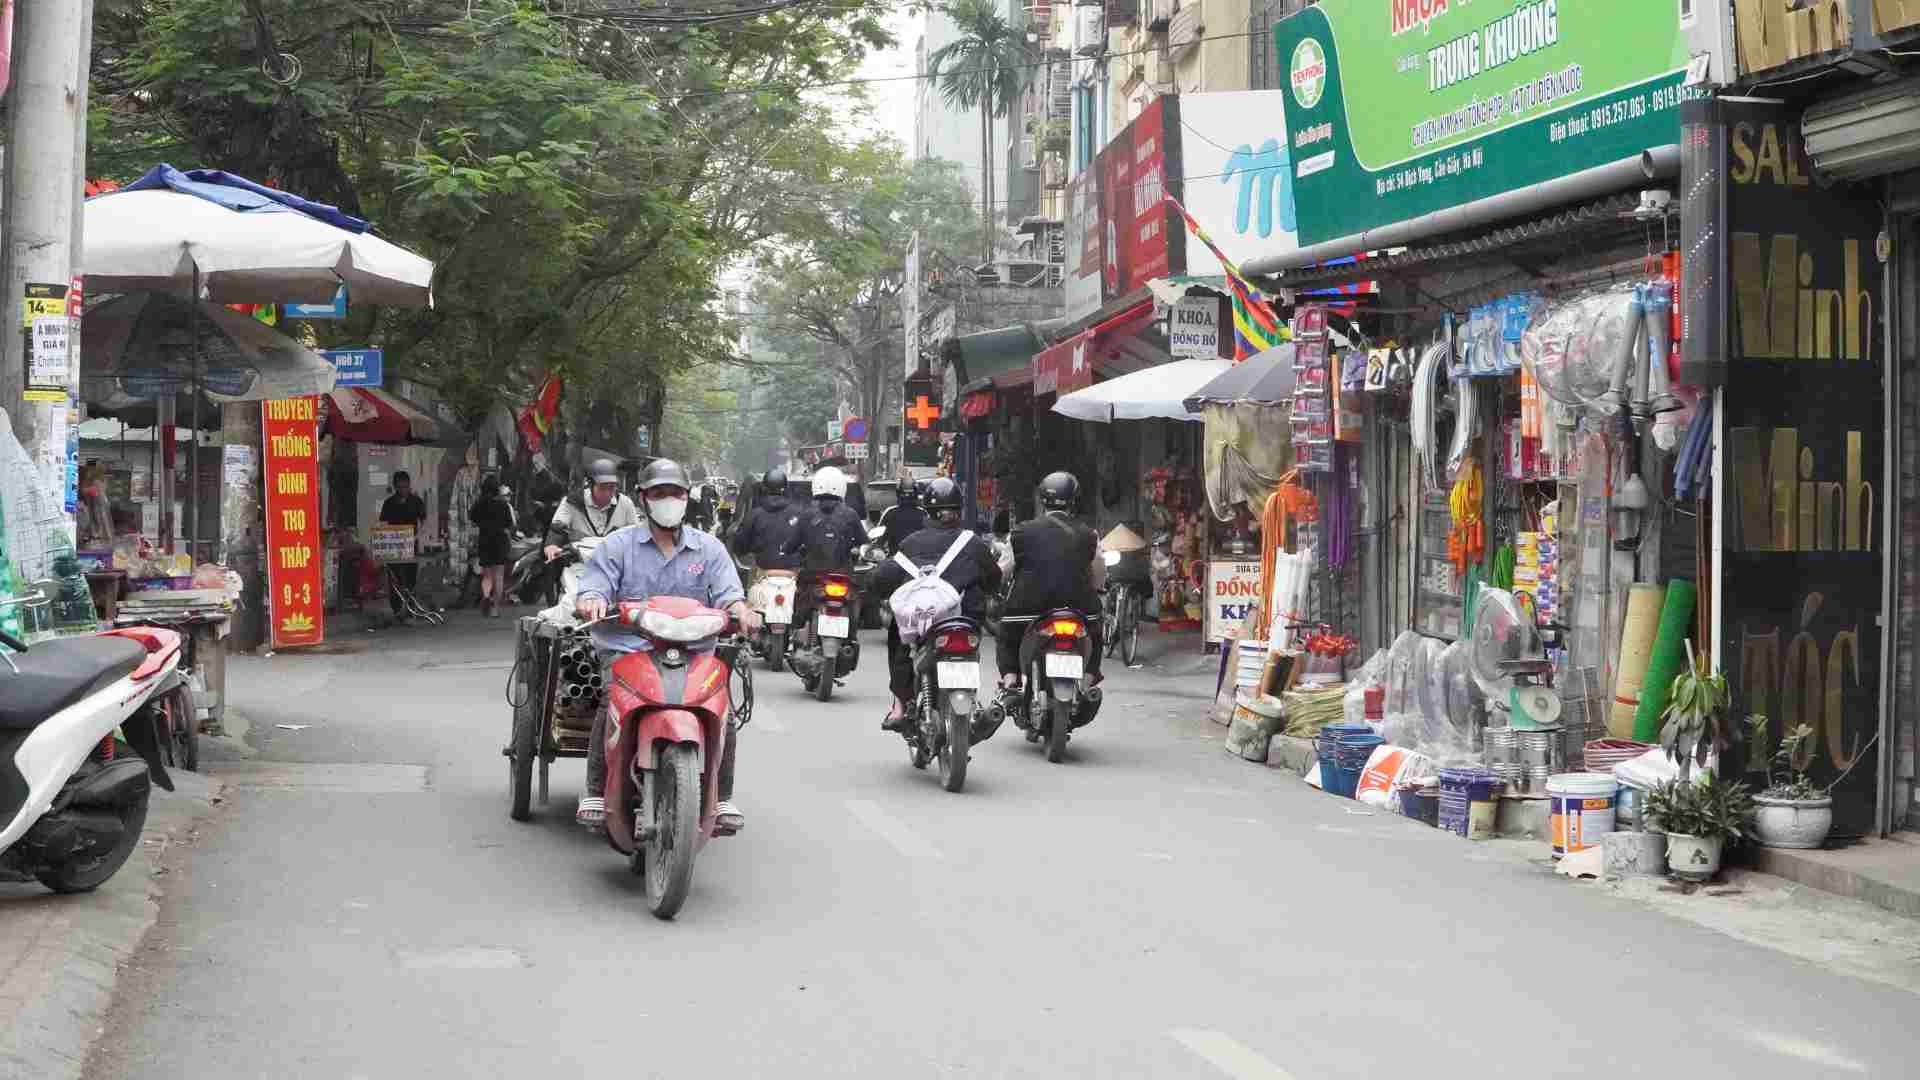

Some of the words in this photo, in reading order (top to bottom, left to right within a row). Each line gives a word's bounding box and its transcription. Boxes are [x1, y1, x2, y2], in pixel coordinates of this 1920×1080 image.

[1427, 31, 1481, 93] TRUNG
[1483, 0, 1558, 71] KHƯƠNG
[1730, 232, 1872, 360] Minh
[271, 427, 312, 457] THỐNG
[1730, 428, 1873, 552] Minh
[282, 508, 306, 536] THỌ
[280, 541, 311, 569] THÁP
